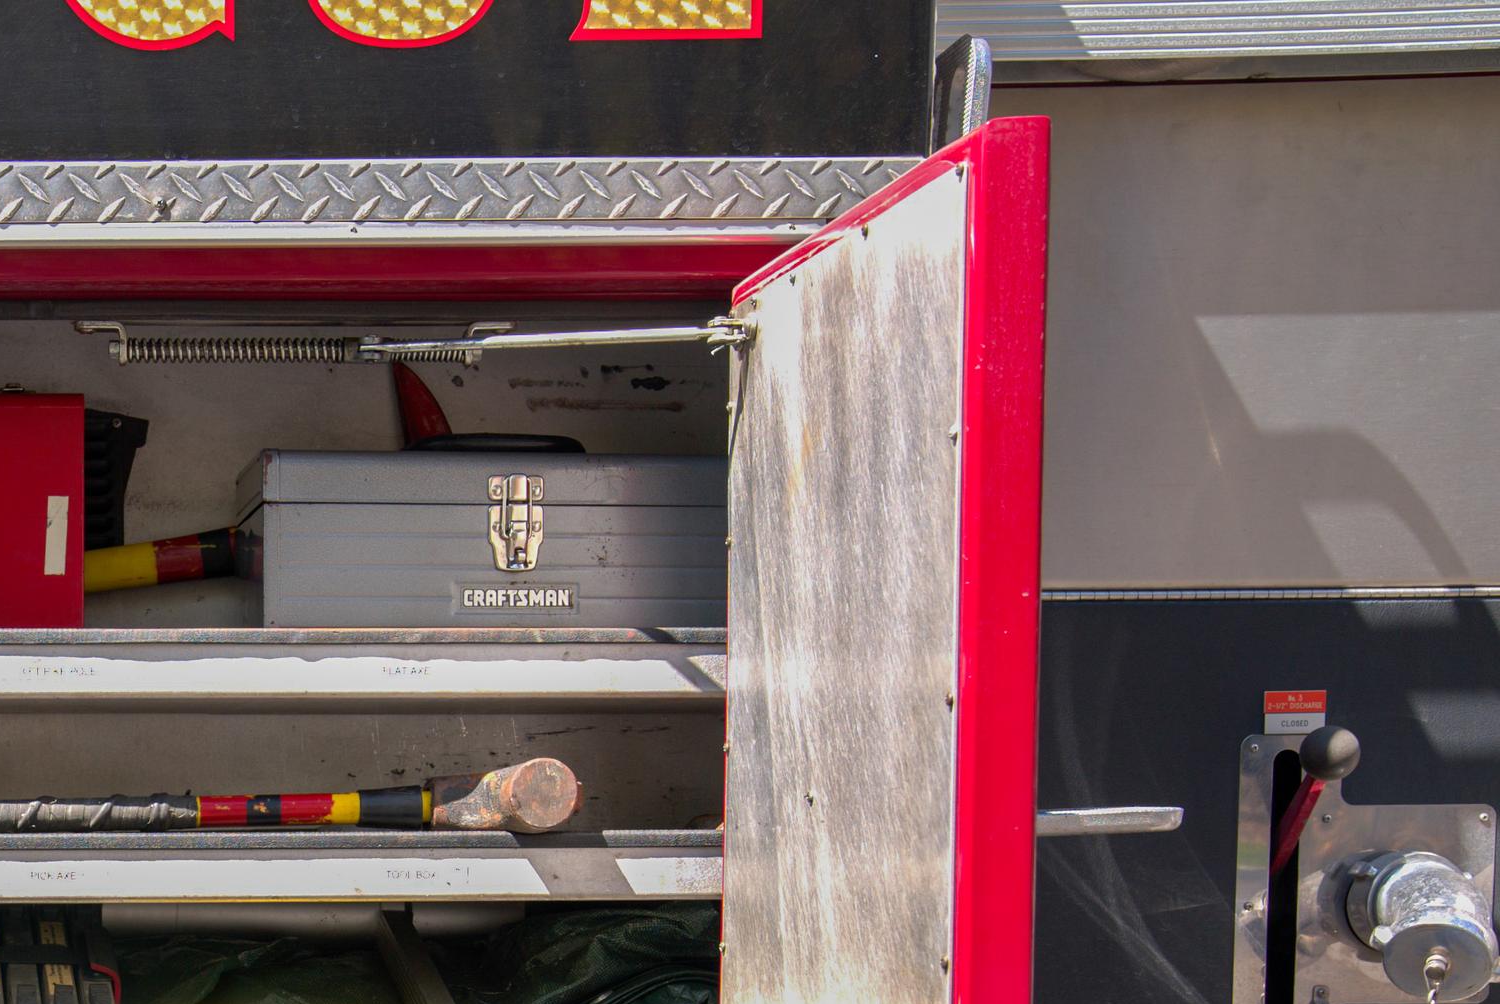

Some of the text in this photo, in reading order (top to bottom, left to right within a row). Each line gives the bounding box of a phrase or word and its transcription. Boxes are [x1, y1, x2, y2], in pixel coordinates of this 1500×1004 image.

[462, 588, 573, 609] CRAFTSMAN
[1289, 701, 1323, 710] DISCHARGE
[1281, 719, 1309, 728] CLOSED
